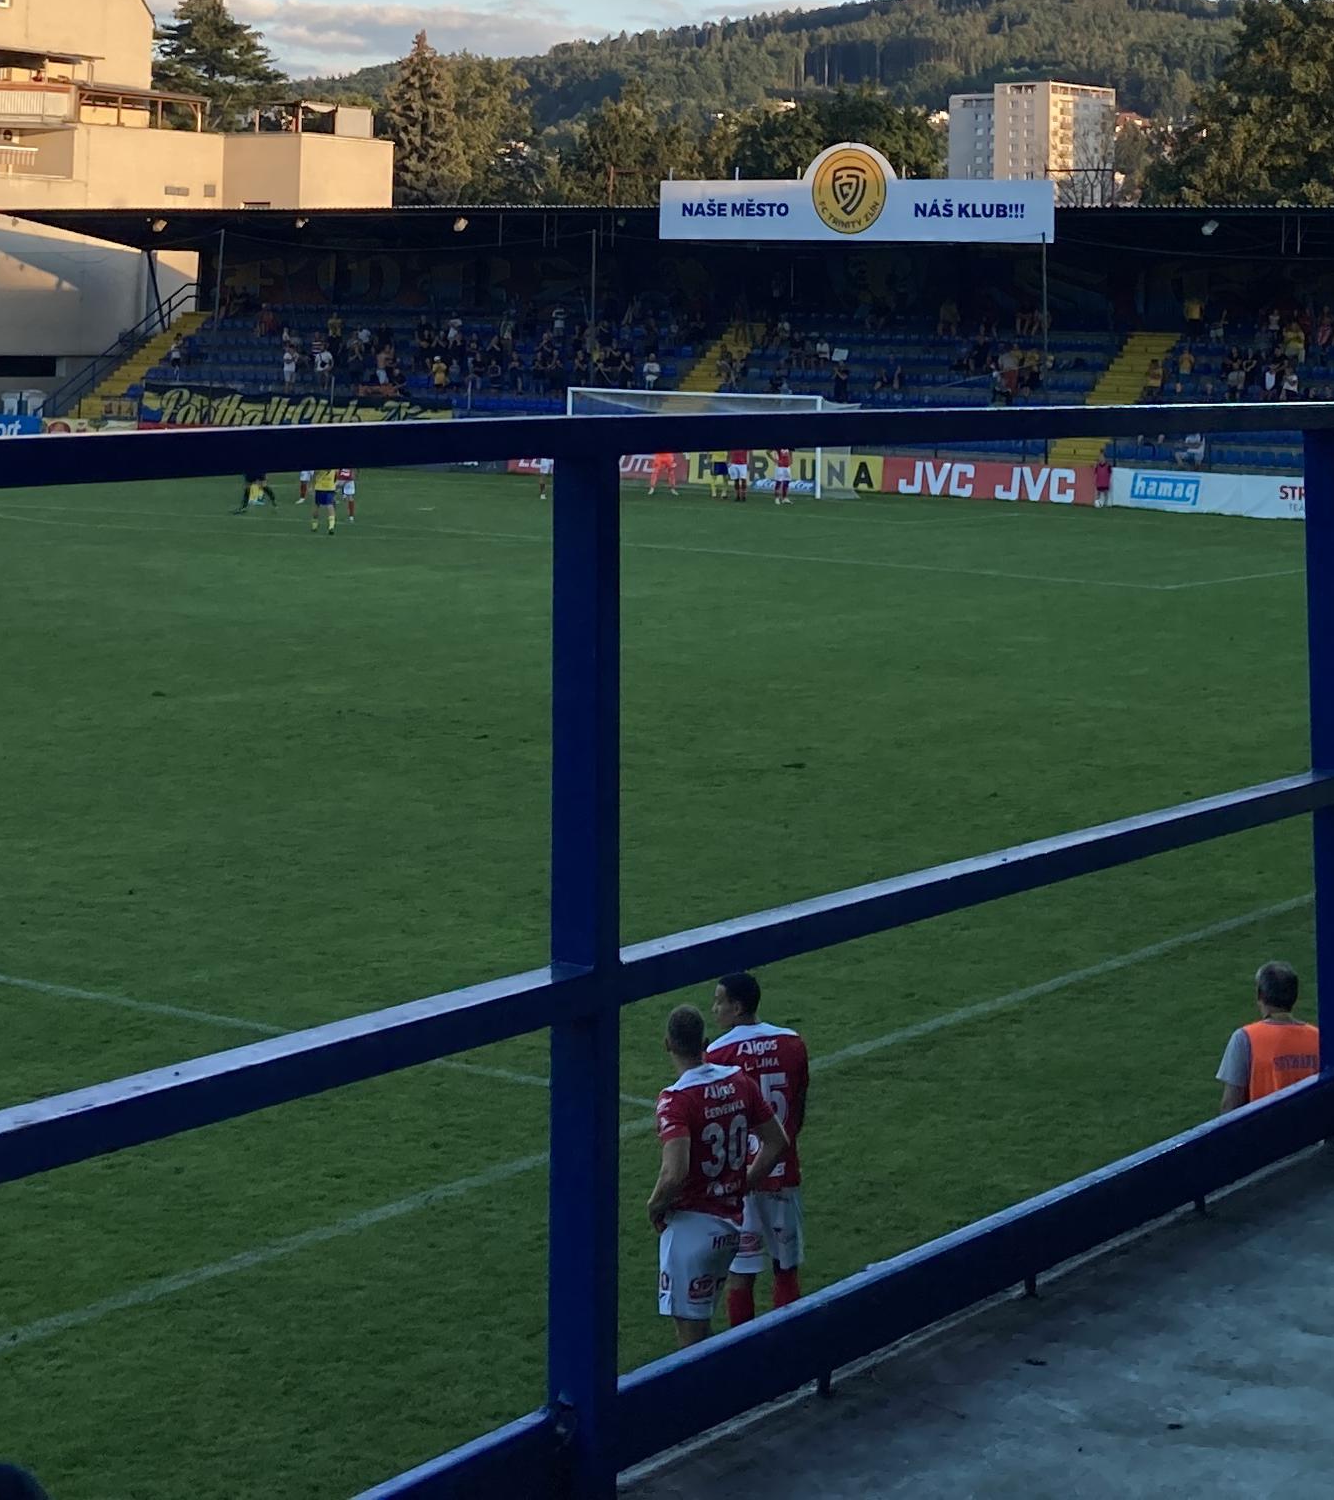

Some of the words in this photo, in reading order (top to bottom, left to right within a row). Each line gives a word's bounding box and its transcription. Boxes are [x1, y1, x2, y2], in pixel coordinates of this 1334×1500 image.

[681, 198, 728, 217] NAŠE
[731, 198, 789, 217] MĚSTO
[914, 198, 954, 218] NÁŠ
[957, 203, 1025, 219] KLUB!!!
[898, 461, 975, 497] JVC
[995, 466, 1076, 504] JVC
[756, 1057, 780, 1069] LIMA
[700, 1114, 748, 1179] 30
